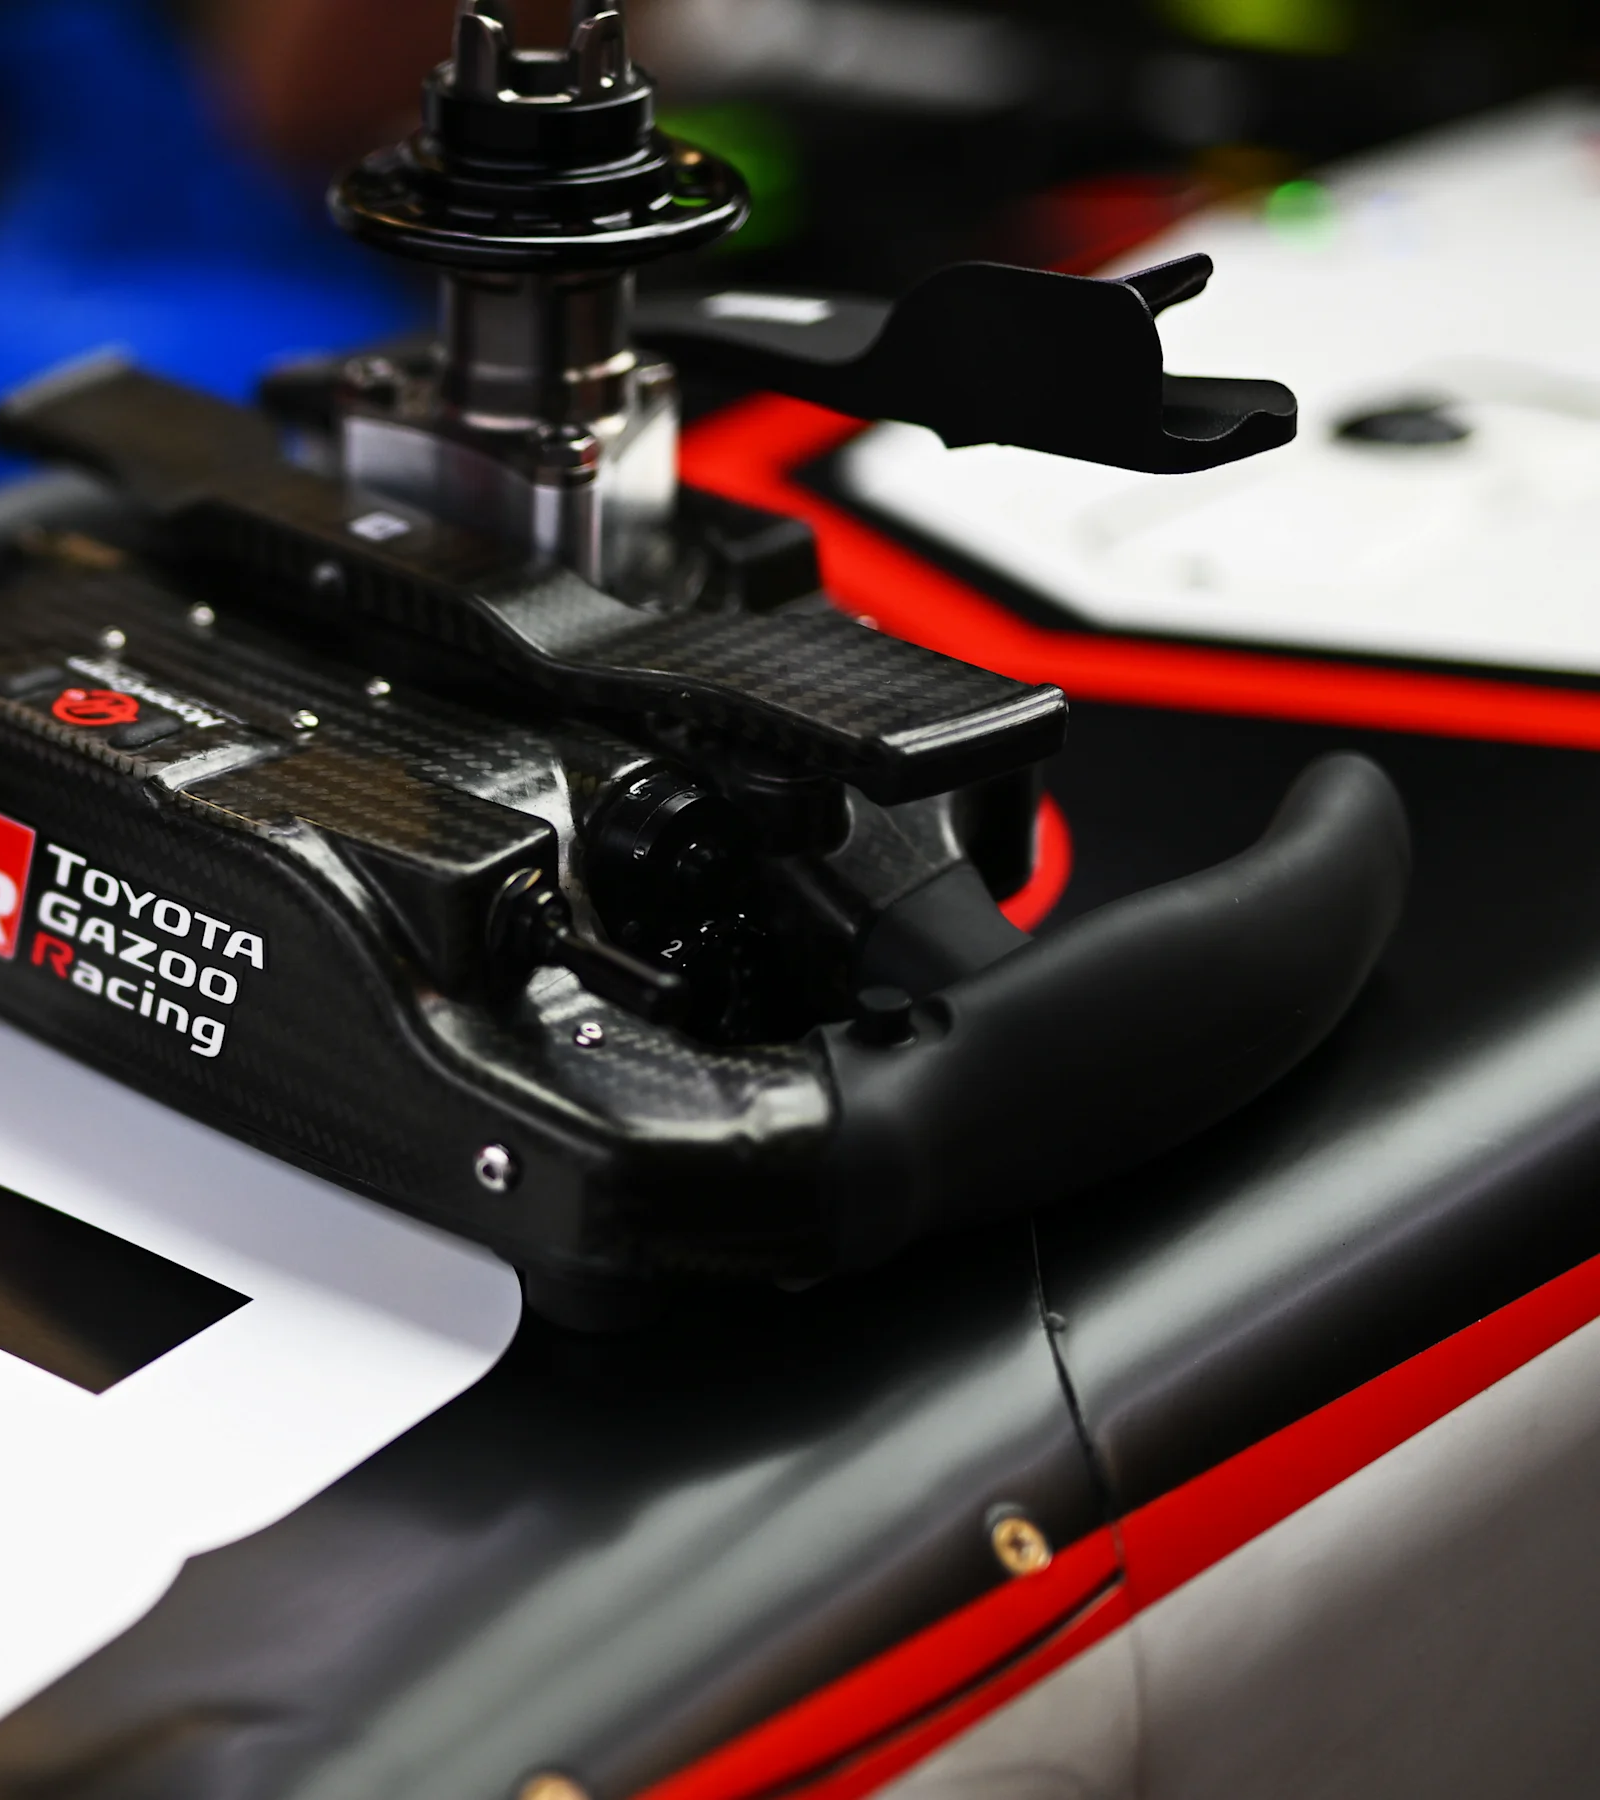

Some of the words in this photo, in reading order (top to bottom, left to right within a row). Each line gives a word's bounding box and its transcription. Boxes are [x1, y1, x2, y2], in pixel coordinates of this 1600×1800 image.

[37, 890, 239, 1005] GAZOO
[47, 843, 265, 970] TOYOTA
[660, 939, 683, 958] 2
[31, 932, 227, 1058] Racing
